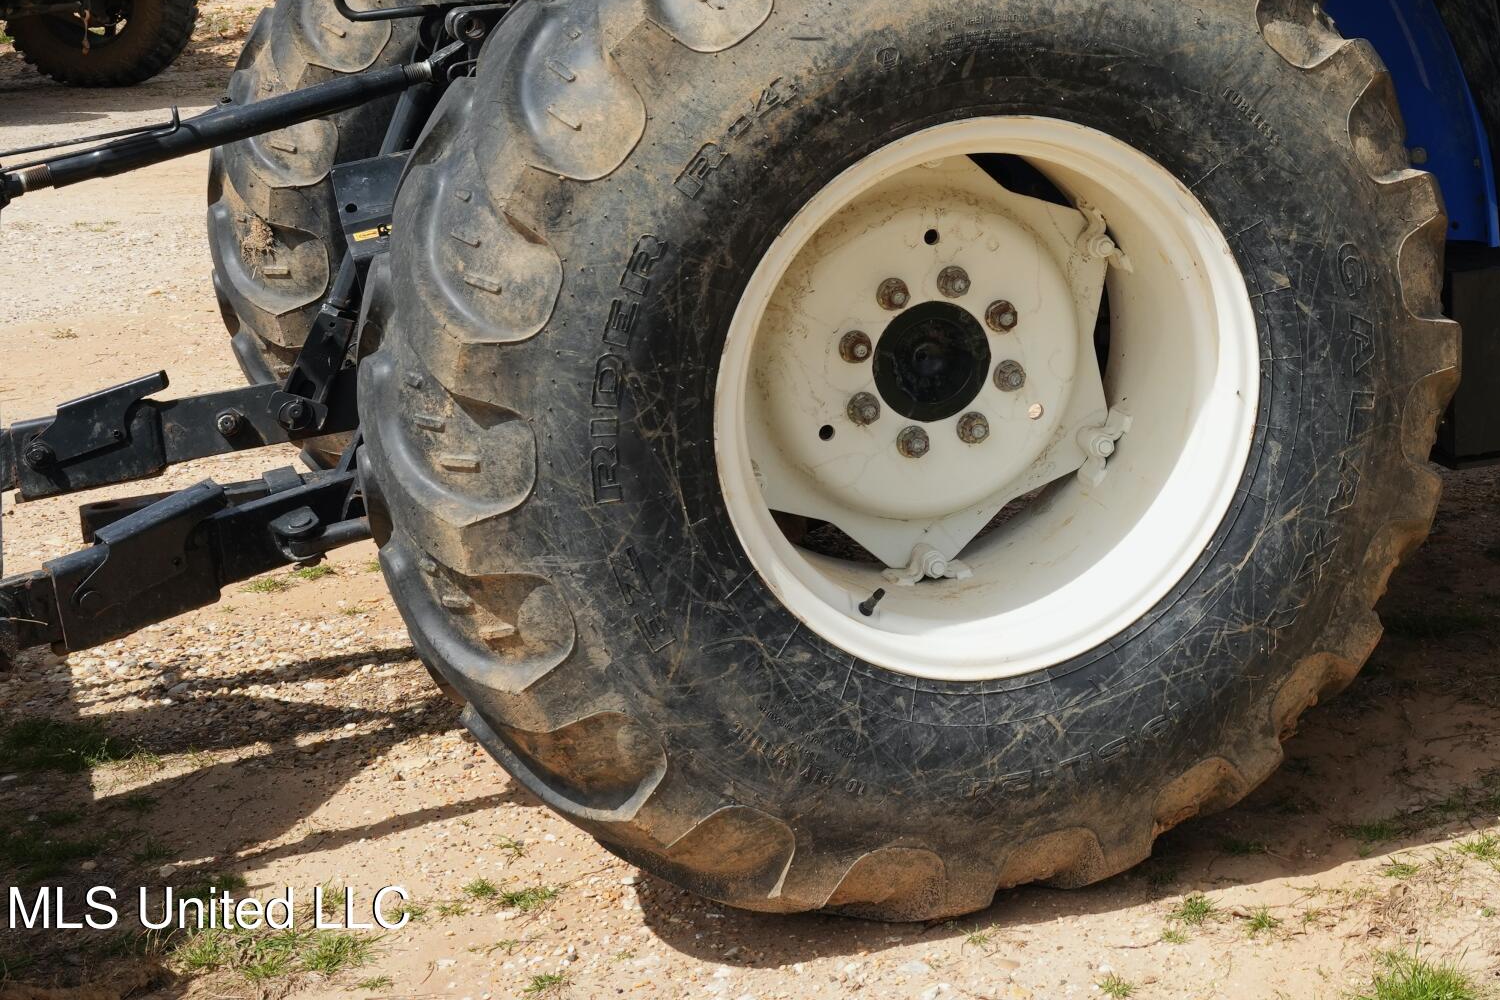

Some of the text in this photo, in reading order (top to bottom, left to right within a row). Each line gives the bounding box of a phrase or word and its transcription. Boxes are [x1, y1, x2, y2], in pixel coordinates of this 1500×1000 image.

[589, 234, 668, 505] RIDER
[673, 76, 800, 199] R-4
[1222, 86, 1283, 145] TUBELESS
[1262, 243, 1377, 657] GALAXY
